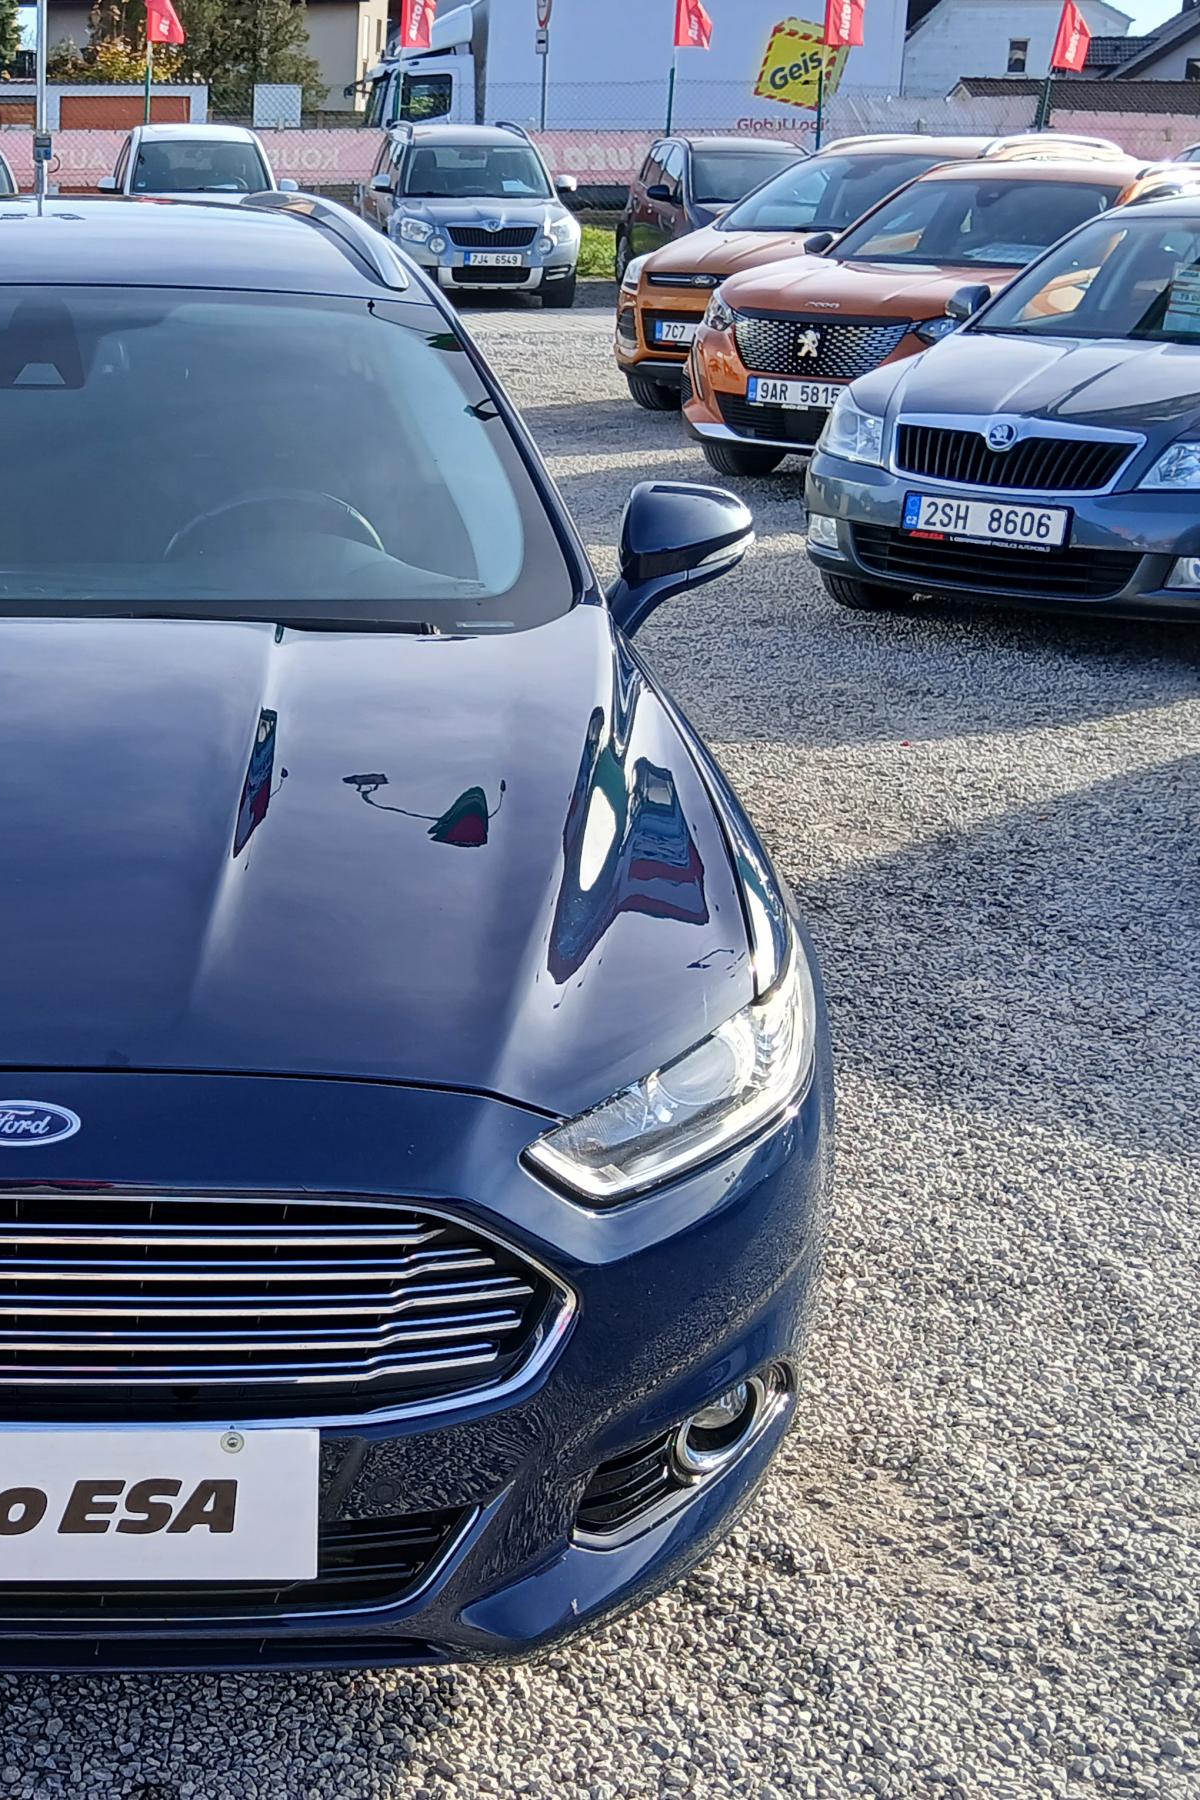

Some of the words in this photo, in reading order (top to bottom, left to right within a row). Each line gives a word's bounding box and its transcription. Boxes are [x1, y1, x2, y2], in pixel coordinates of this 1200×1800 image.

[769, 50, 823, 90] Geis
[472, 254, 489, 264] 7J4
[495, 255, 518, 265] 6549
[665, 324, 686, 340] 7C7
[760, 382, 789, 401] 9AR
[800, 385, 841, 405] 5815
[923, 501, 970, 530] 2SH
[987, 508, 1052, 539] 8606
[57, 1478, 238, 1534] ESA
